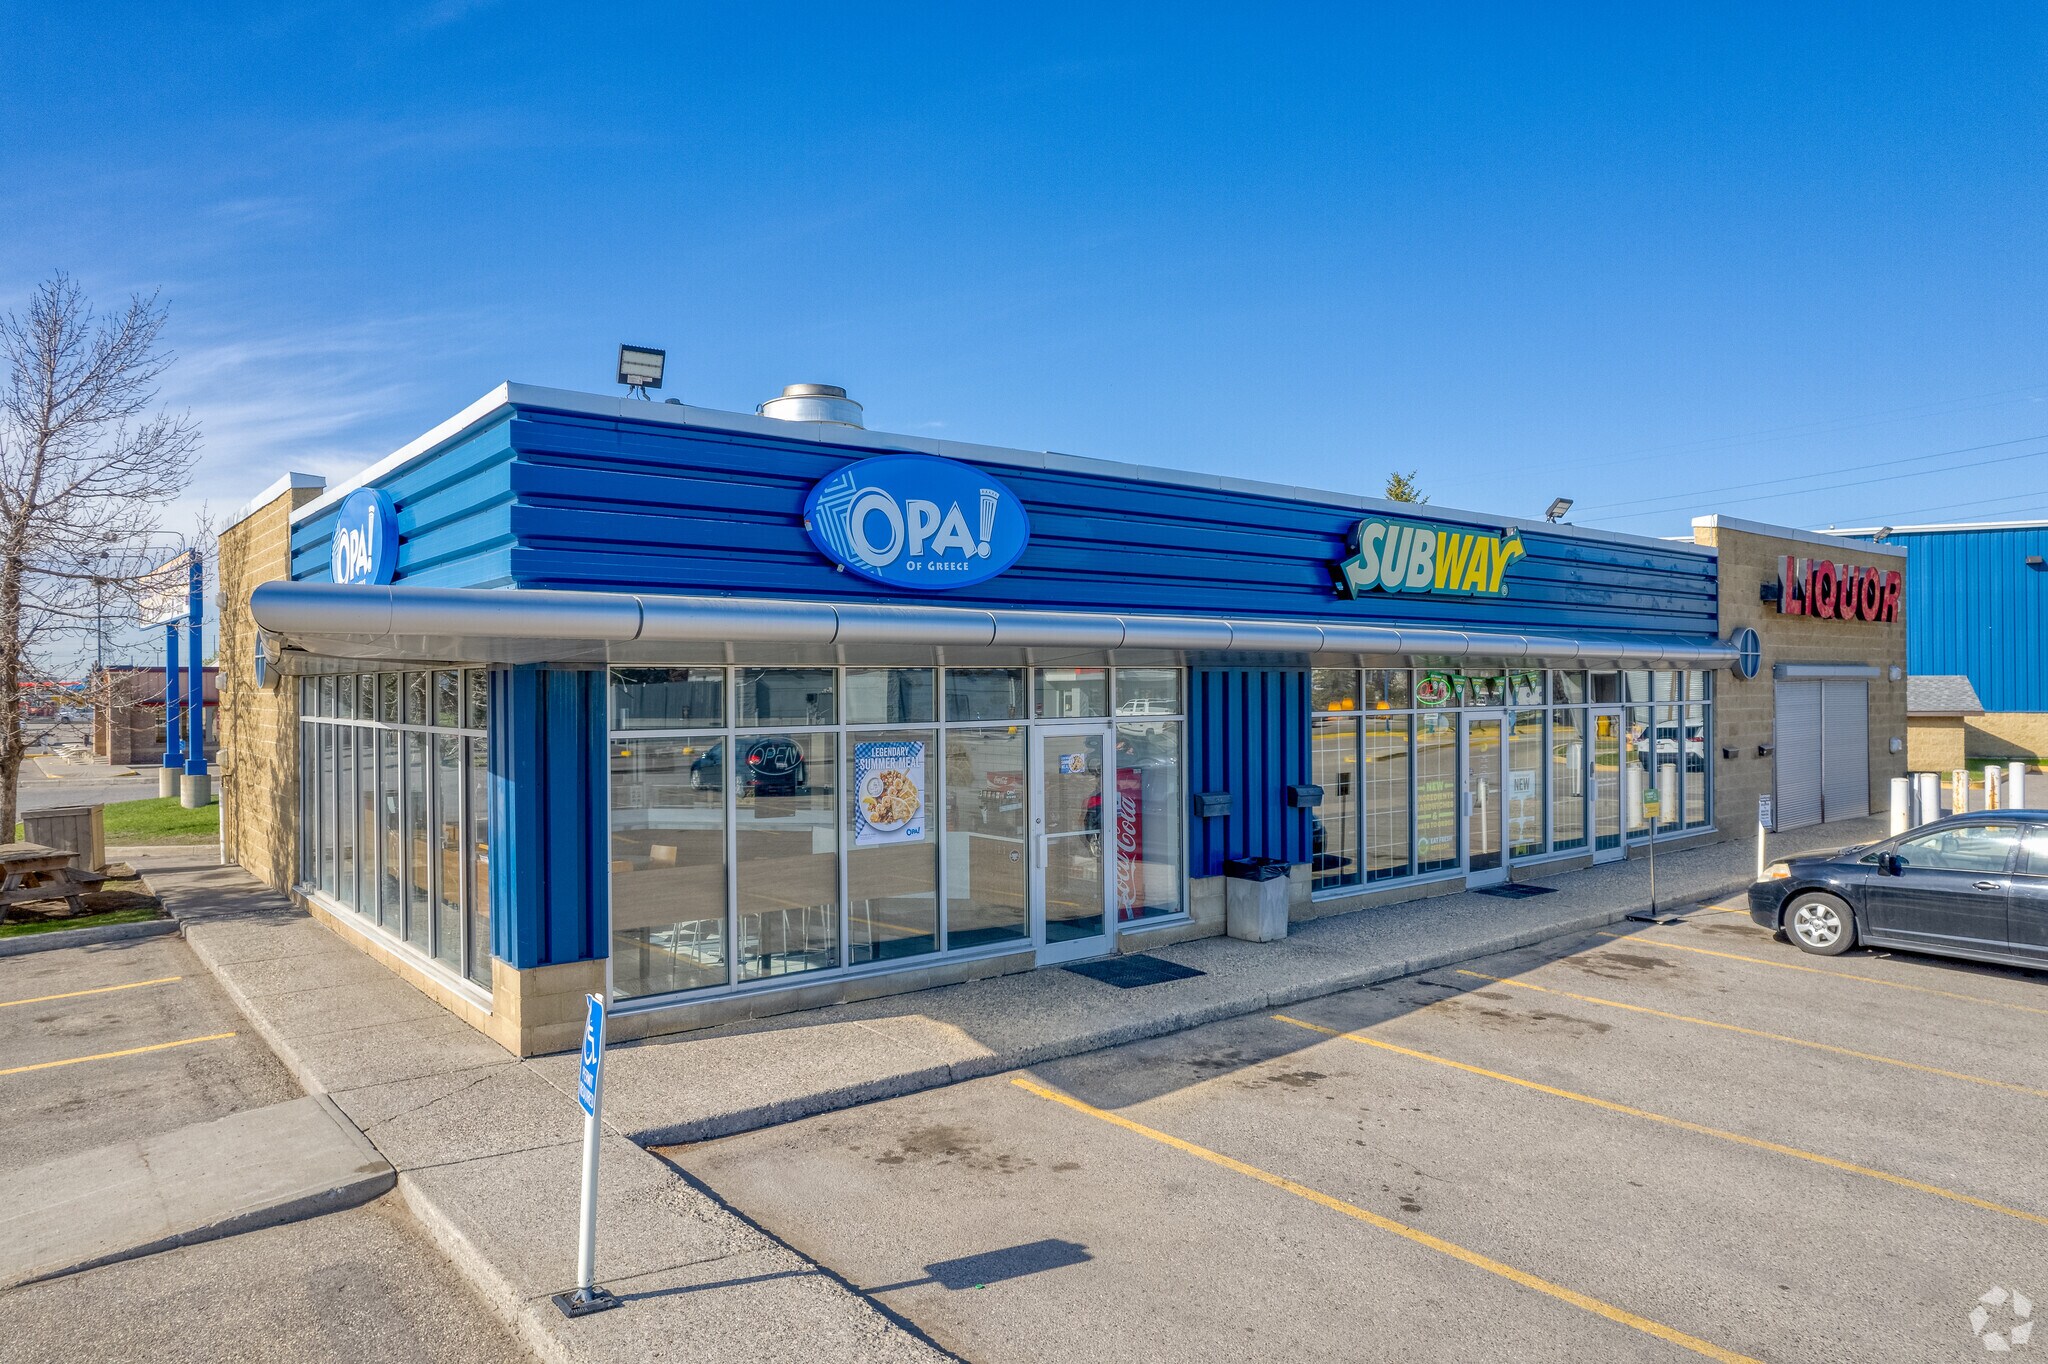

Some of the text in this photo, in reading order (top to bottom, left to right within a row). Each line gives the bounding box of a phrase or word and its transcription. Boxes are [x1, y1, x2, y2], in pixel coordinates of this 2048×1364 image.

[847, 487, 1000, 566] OPA!
[336, 505, 375, 584] OPA!
[1346, 523, 1524, 592] SUBWAY
[906, 560, 969, 571] OF GREECE
[1785, 555, 1902, 623] LIQUOR
[752, 746, 799, 766] OPEN
[871, 746, 910, 757] LEGENDARY
[860, 756, 920, 770] SUMMER MEAL
[1425, 780, 1444, 792] NEW
[1514, 776, 1530, 791] NEW
[906, 827, 921, 836] OPA!
